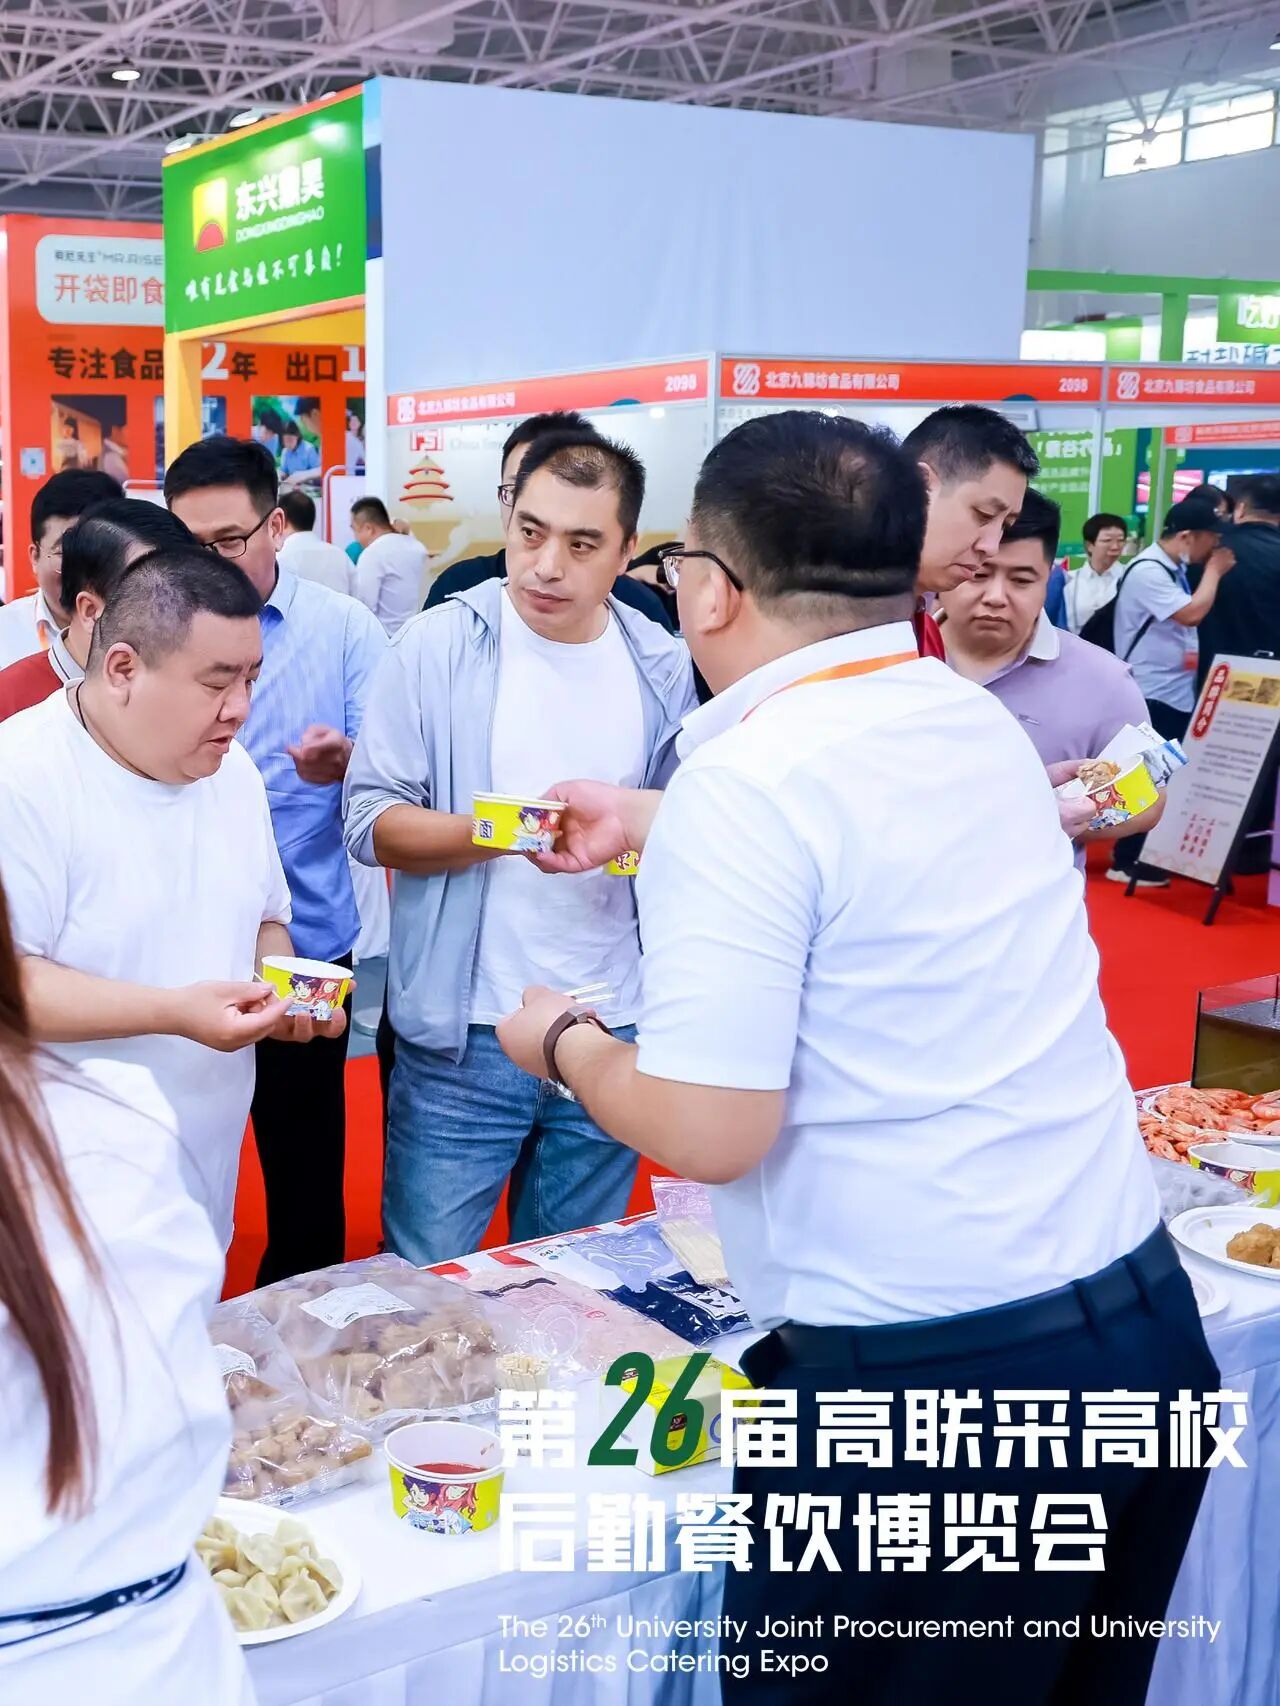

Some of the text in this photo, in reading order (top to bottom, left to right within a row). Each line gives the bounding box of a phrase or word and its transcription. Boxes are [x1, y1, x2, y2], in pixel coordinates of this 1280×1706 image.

[55, 273, 164, 305] 开袋即食
[48, 346, 163, 380] 专注食品
[664, 373, 697, 393] 2098
[1058, 378, 1088, 393] 2098
